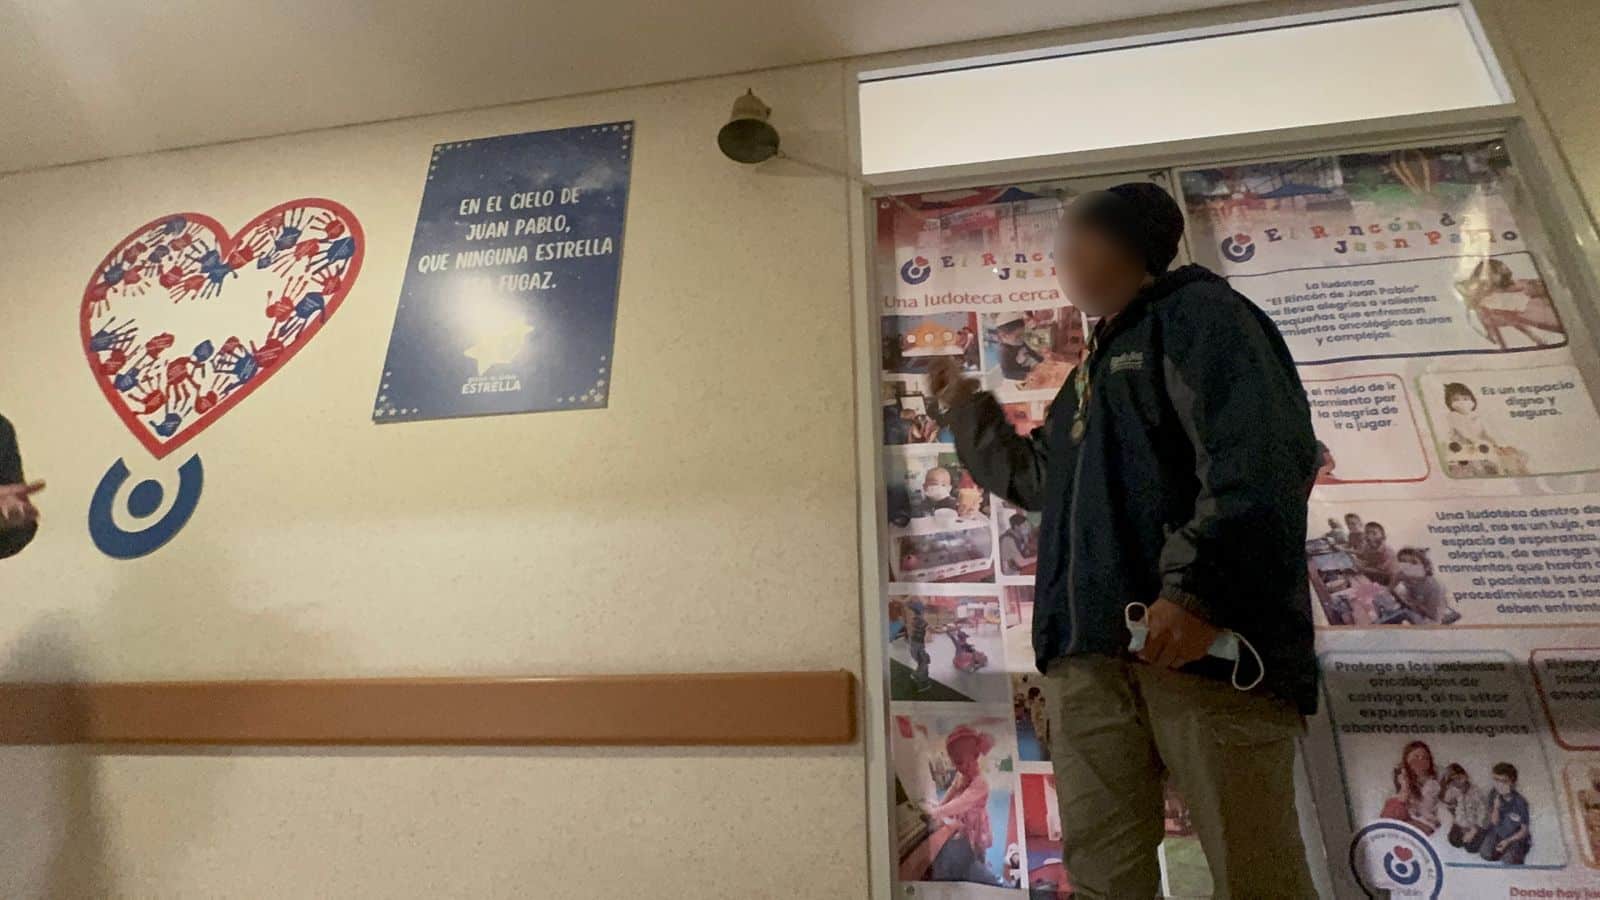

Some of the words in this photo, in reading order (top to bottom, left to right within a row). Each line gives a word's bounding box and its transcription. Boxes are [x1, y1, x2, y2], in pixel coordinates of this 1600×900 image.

[460, 199, 481, 215] EN
[486, 196, 503, 212] EL
[510, 190, 554, 210] CIELO
[561, 187, 580, 205] DE
[466, 221, 509, 241] JUAN
[515, 215, 571, 236] PABLO,
[418, 254, 449, 274] QUE
[456, 246, 528, 269] NINGUNA
[535, 237, 613, 261] ESTRELLA
[502, 271, 557, 291] FUGAZ.
[1321, 278, 1375, 290] ludoteca
[884, 295, 918, 308] Una
[925, 291, 1003, 308] ludoteca
[1008, 289, 1060, 303] cerca
[1329, 290, 1344, 299] de
[1347, 288, 1378, 298] Juan
[1266, 307, 1281, 316] ue
[1284, 304, 1314, 315] lleva
[1369, 299, 1378, 307] a
[1381, 294, 1437, 305] valientes
[1339, 311, 1362, 321] que
[1364, 306, 1426, 317] enfrentan
[1416, 314, 1453, 325] duros
[1316, 337, 1323, 346] y
[462, 380, 520, 394] ESTRELLA
[1324, 384, 1366, 395] miedo
[1368, 383, 1385, 392] de
[1387, 382, 1396, 390] ir
[1481, 386, 1495, 395] Es
[1499, 386, 1515, 395] un
[1517, 381, 1575, 395] espacio
[1311, 396, 1372, 407] tamiento
[1374, 394, 1396, 406] por
[1505, 396, 1544, 408] digno
[1547, 396, 1555, 406] y
[1318, 410, 1330, 418] la
[1382, 406, 1398, 415] de
[1334, 421, 1342, 429] ir
[1345, 421, 1354, 429] a
[1435, 510, 1465, 521] Una
[1466, 508, 1528, 520] ludoteca
[1529, 507, 1579, 518] dentro
[1490, 523, 1509, 532] no
[1511, 522, 1527, 532] es
[1530, 521, 1548, 531] un
[1441, 536, 1495, 549] espacio
[1498, 535, 1515, 545] de
[1511, 549, 1529, 558] de
[1532, 546, 1592, 559] entrega
[1438, 562, 1514, 573] momentos
[1516, 562, 1544, 574] que
[1472, 575, 1486, 586] al
[1488, 575, 1550, 588] paciente
[1552, 574, 1576, 585] los
[1453, 588, 1566, 603] procedimientos
[1568, 588, 1578, 598] a
[1496, 603, 1544, 614] deben
[1335, 661, 1393, 675] Protege
[1395, 662, 1406, 672] a
[1407, 660, 1433, 672] los
[1434, 660, 1506, 674] pacientes
[1460, 677, 1479, 687] de
[1439, 706, 1460, 718] en
[1509, 886, 1553, 898] Donde
